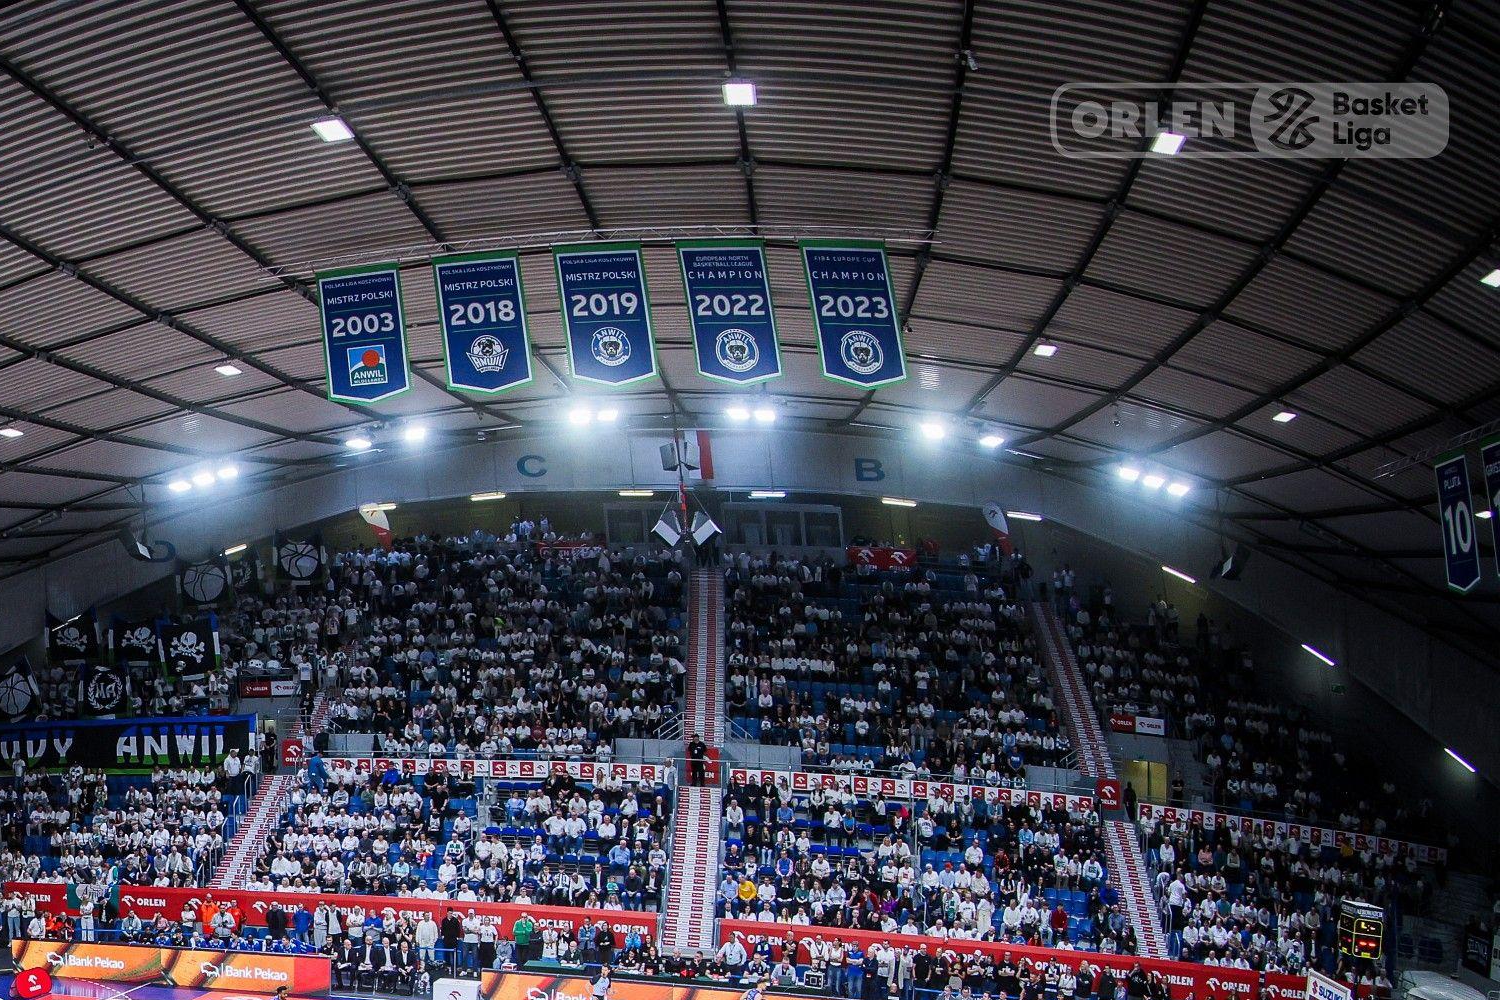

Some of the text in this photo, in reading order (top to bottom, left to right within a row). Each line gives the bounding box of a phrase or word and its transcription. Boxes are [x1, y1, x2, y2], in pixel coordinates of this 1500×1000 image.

[565, 270, 636, 281] MISTRZ POLSKI
[688, 270, 763, 279] CHAMPION
[812, 270, 885, 281] CHAMPION
[444, 278, 513, 292] MISTRZ POLSKI
[327, 290, 393, 305] MISTRZ POLSKI
[571, 292, 638, 317] 2019
[695, 294, 765, 316] 2022
[450, 300, 516, 326] 2018
[819, 295, 889, 318] 2023
[332, 312, 395, 337] 2003
[594, 328, 625, 341] ANWIL
[722, 334, 751, 345] ANWIL
[847, 335, 874, 347] ANWIL
[353, 369, 384, 379] ANWIL
[517, 454, 547, 478] C
[855, 457, 886, 482] B
[1444, 501, 1472, 555] 10
[136, 898, 166, 907] ORLEN
[69, 954, 124, 970] Bank Pekao
[225, 965, 288, 982] Bank Pekao
[1221, 981, 1250, 993] ORLEN
